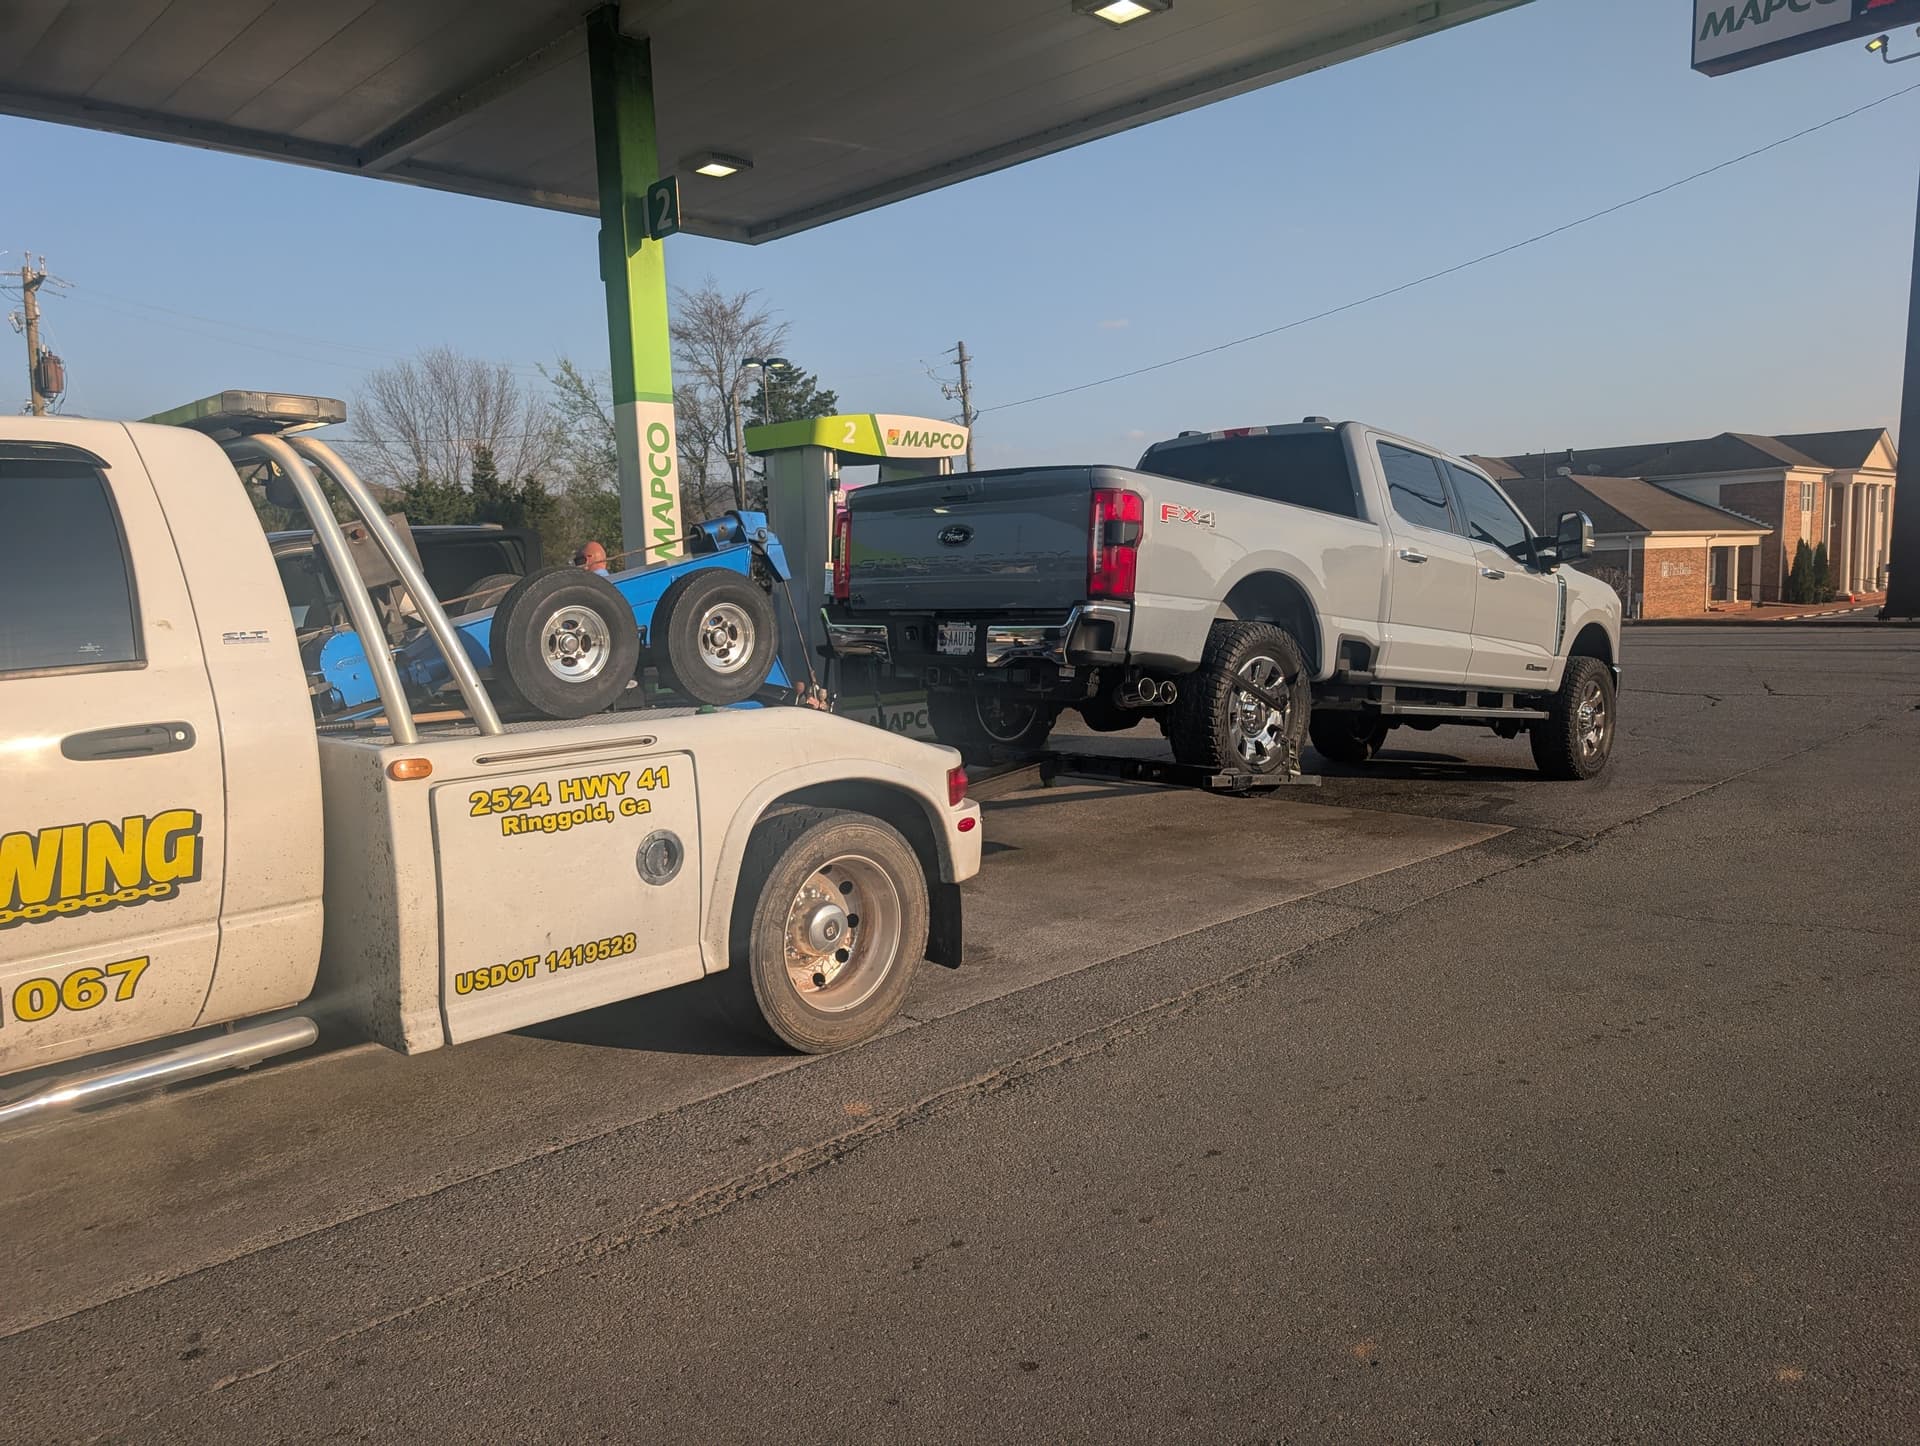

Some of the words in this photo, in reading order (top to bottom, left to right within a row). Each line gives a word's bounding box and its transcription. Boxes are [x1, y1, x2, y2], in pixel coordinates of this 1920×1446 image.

[656, 188, 673, 231] 2
[842, 421, 857, 444] 2
[901, 430, 964, 450] MAPCO
[646, 422, 677, 560] MAPCO
[1160, 503, 1216, 528] FX4
[470, 783, 550, 816] 2524
[559, 771, 629, 803] HWY
[637, 766, 670, 790] 41
[502, 804, 615, 836] Ringgold,
[620, 798, 651, 816] Ga
[455, 956, 541, 994] USDOT
[545, 932, 637, 973] 1419528
[0, 957, 151, 1028] 067
